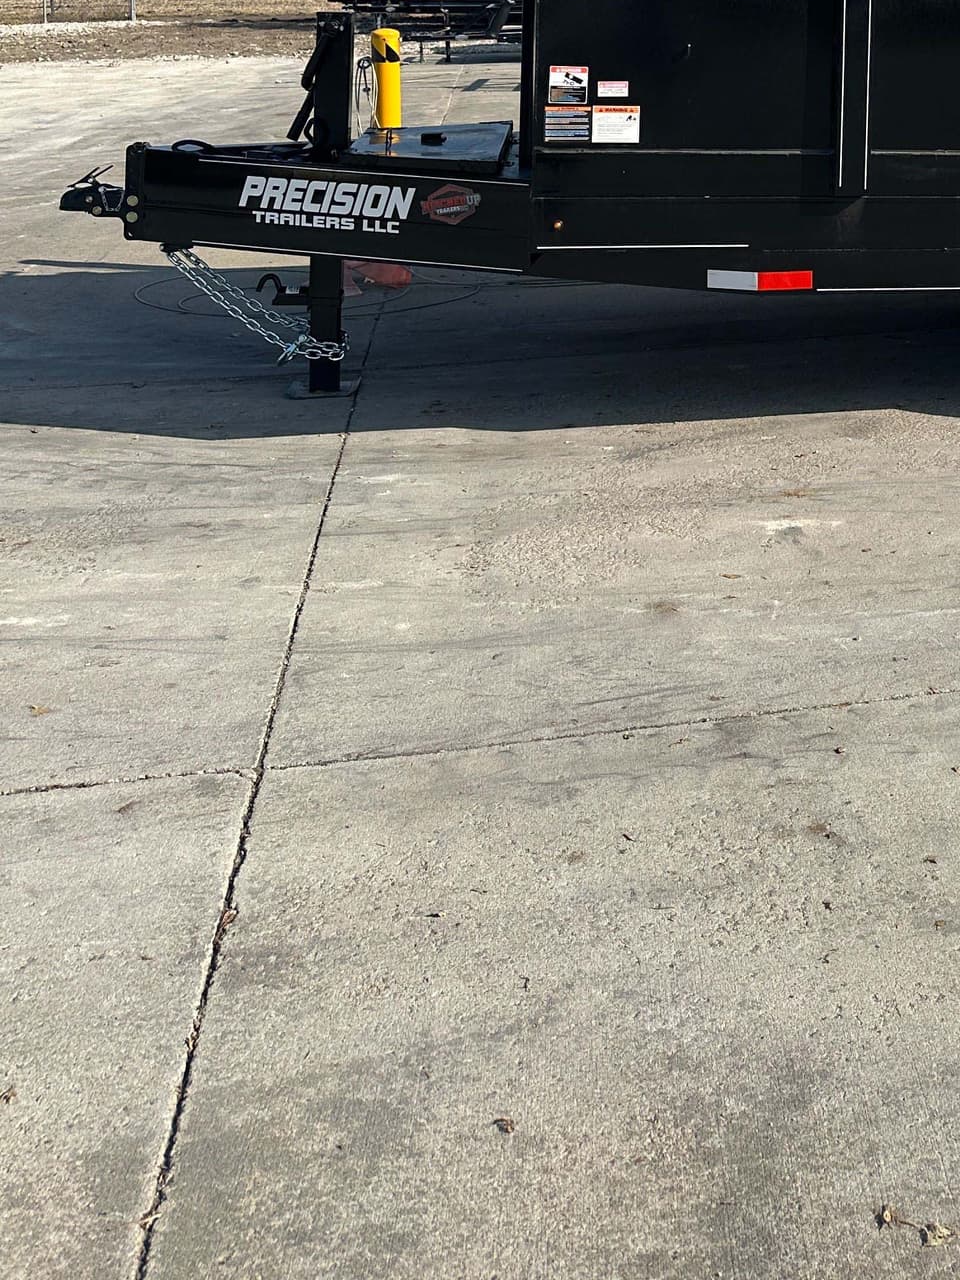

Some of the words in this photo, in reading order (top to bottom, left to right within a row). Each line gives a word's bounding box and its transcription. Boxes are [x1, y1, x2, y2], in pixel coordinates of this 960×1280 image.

[238, 175, 416, 220] PRECISION
[252, 210, 355, 231] TRAILERS
[362, 219, 400, 234] LLC
